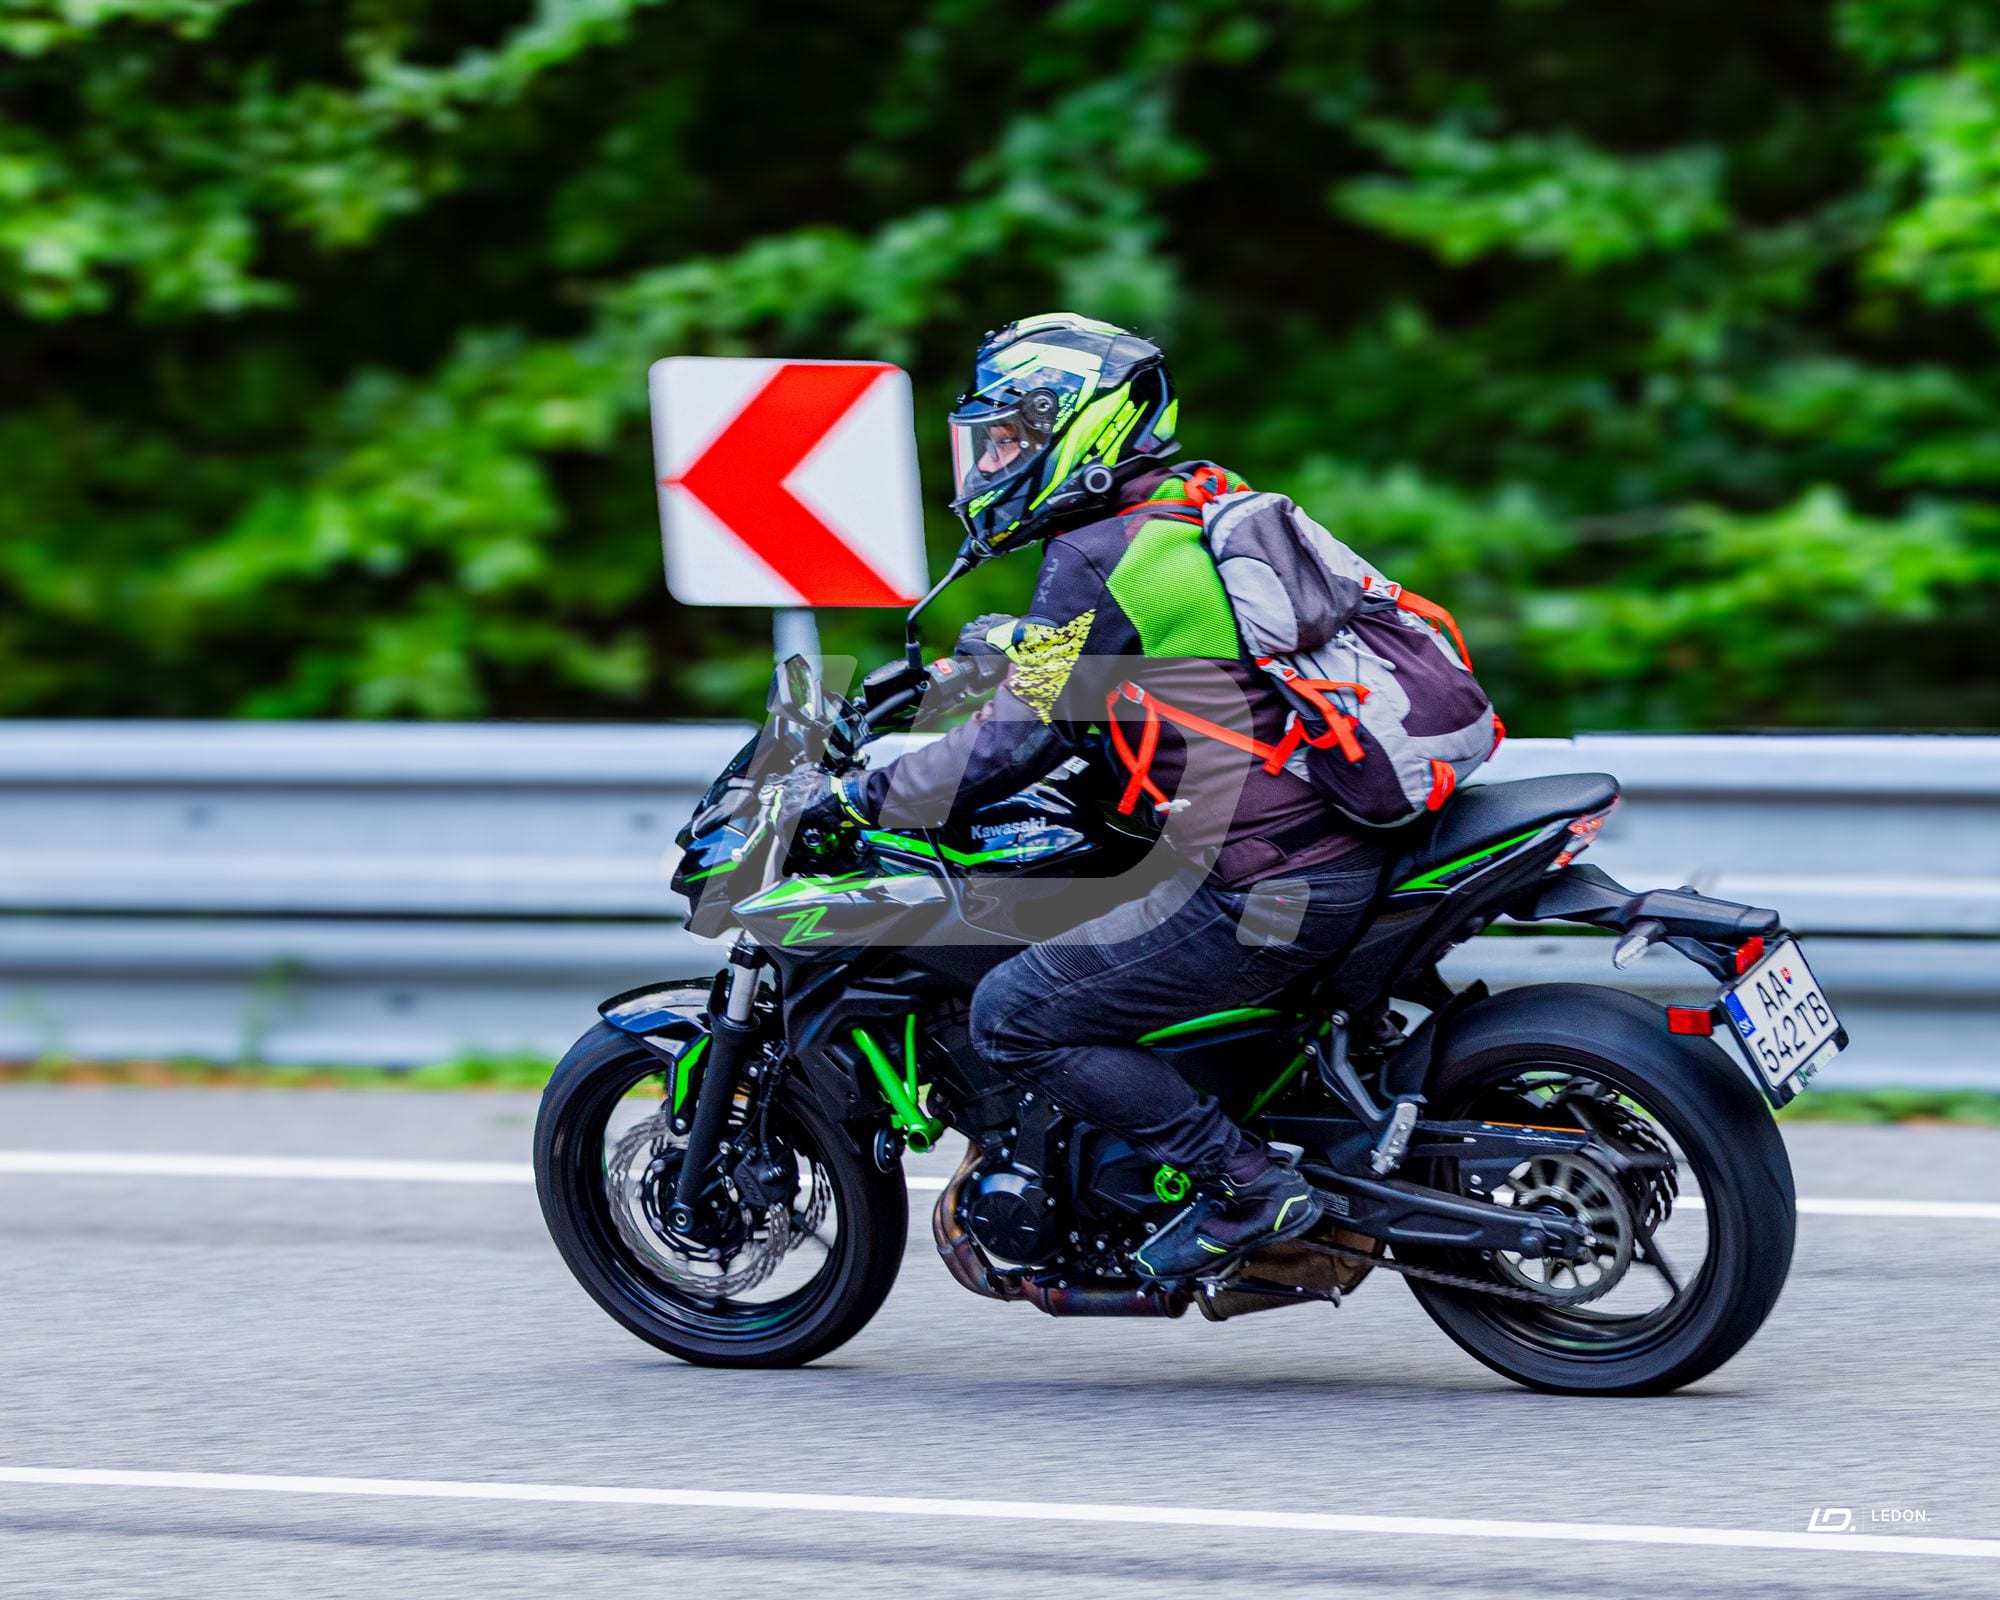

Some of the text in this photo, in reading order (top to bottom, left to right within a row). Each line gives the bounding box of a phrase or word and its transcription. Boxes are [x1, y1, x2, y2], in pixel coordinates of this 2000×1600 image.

[970, 816, 1047, 840] Kawasaki
[777, 906, 834, 946] Z
[1756, 969, 1791, 1019] AA
[1756, 991, 1829, 1073] 542TB
